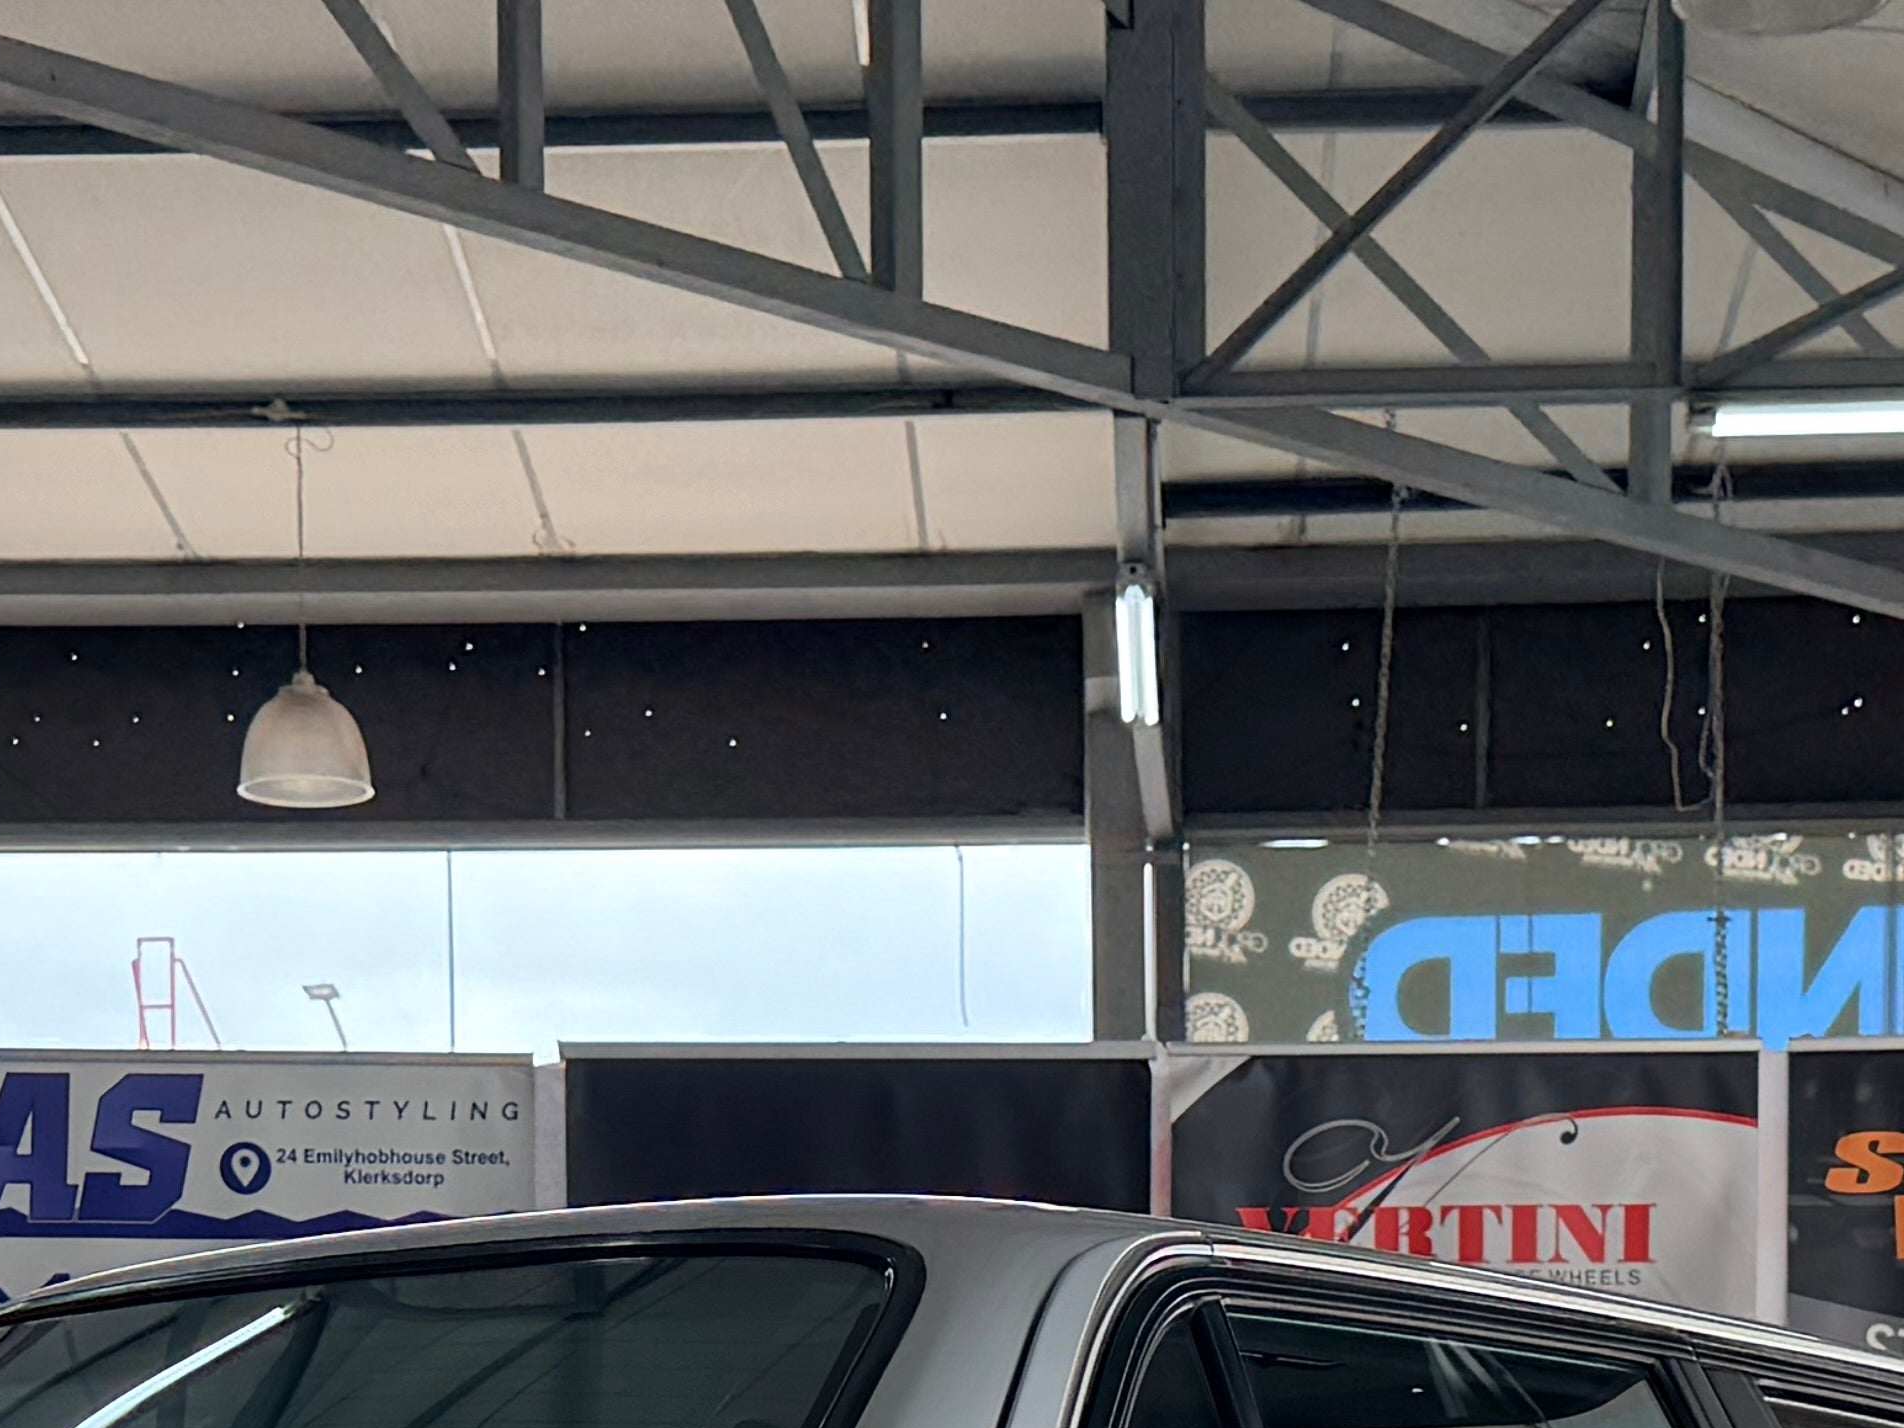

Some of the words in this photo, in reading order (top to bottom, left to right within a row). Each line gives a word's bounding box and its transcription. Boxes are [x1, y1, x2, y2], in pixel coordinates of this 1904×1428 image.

[215, 1099, 521, 1121] AUTOSTYLING
[275, 1148, 297, 1163] 24
[303, 1147, 446, 1168] Emilyhobhouse
[452, 1149, 510, 1167] Street,
[343, 1169, 445, 1188] Klerksdorp
